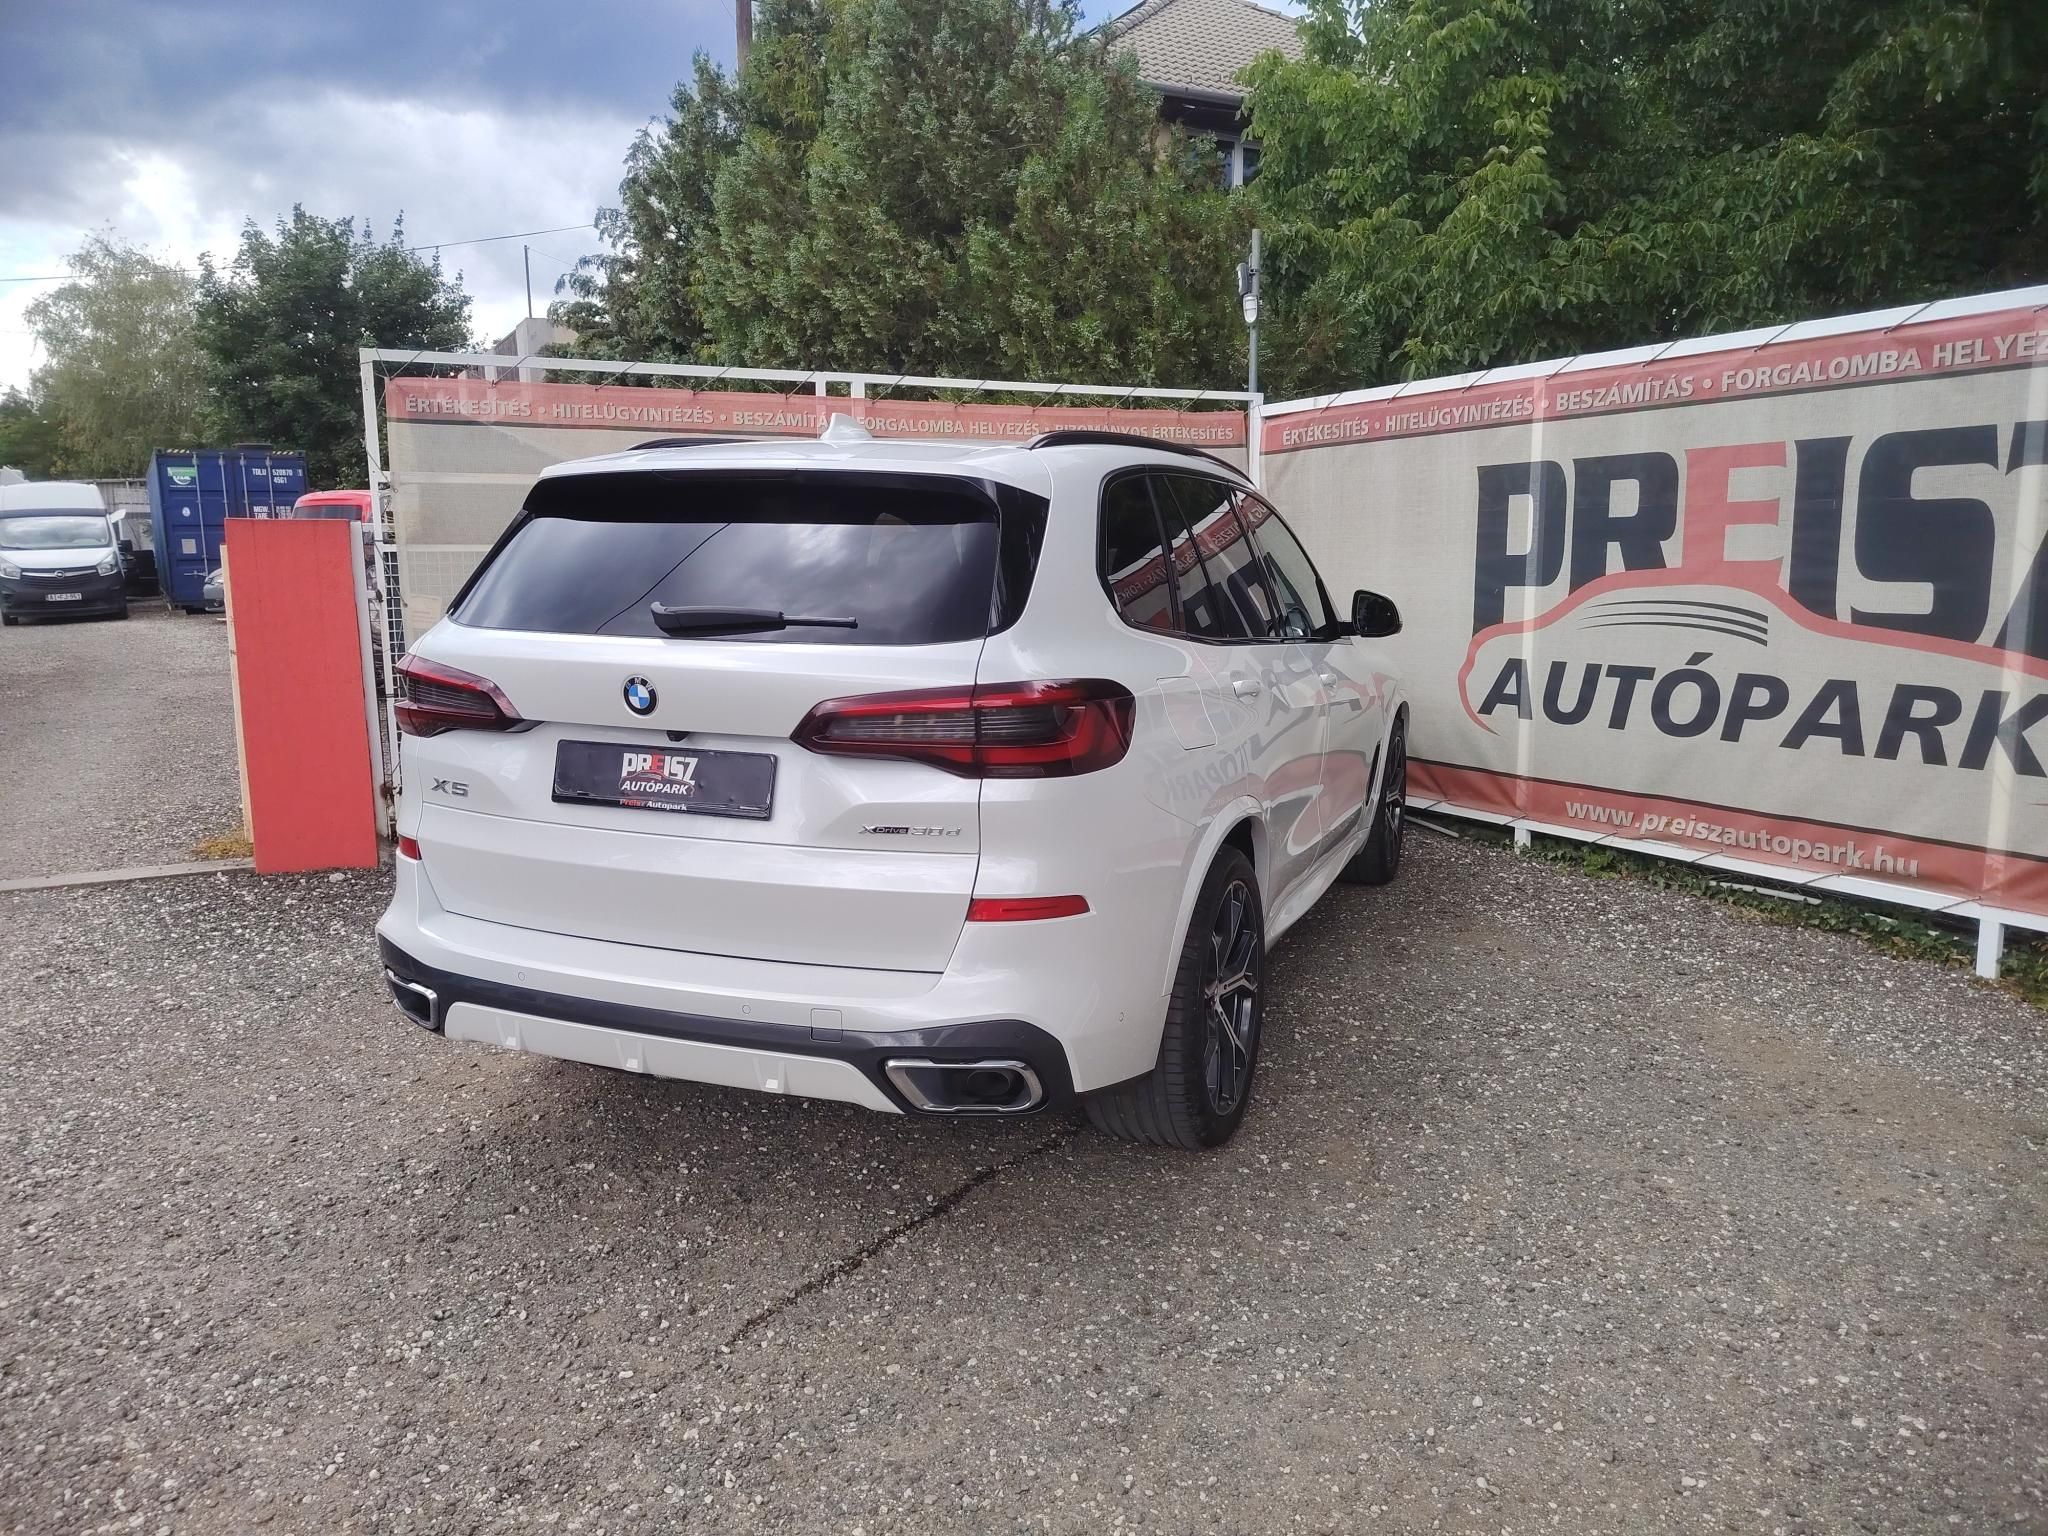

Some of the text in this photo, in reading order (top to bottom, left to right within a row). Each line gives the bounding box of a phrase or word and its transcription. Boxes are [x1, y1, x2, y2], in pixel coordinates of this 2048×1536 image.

[405, 393, 532, 417] ÉRTÉKESÍTÉS
[552, 402, 715, 425] HITELÜGYINTÉZÉS
[732, 408, 829, 429] BESZÁMÍTÁ
[969, 420, 1040, 436] HELYEZÉS
[1152, 425, 1234, 441] ÉRTÉKESÍTÉS
[1282, 417, 1369, 446] ÉRTÉKESÍTÉS
[1385, 394, 1535, 433] HITELÜGYINTÉZÉS
[1556, 374, 1695, 411] BESZÁMÍTÁS
[1721, 348, 1923, 392] FORGALOMBA
[1478, 652, 2048, 778] AUTÓPARK
[431, 776, 470, 797] X5
[621, 752, 699, 786] PREISZ
[621, 780, 689, 795] AUTÓPARK
[646, 799, 687, 812] Autopark
[1565, 800, 1920, 878] www.preiszautopark.hu
